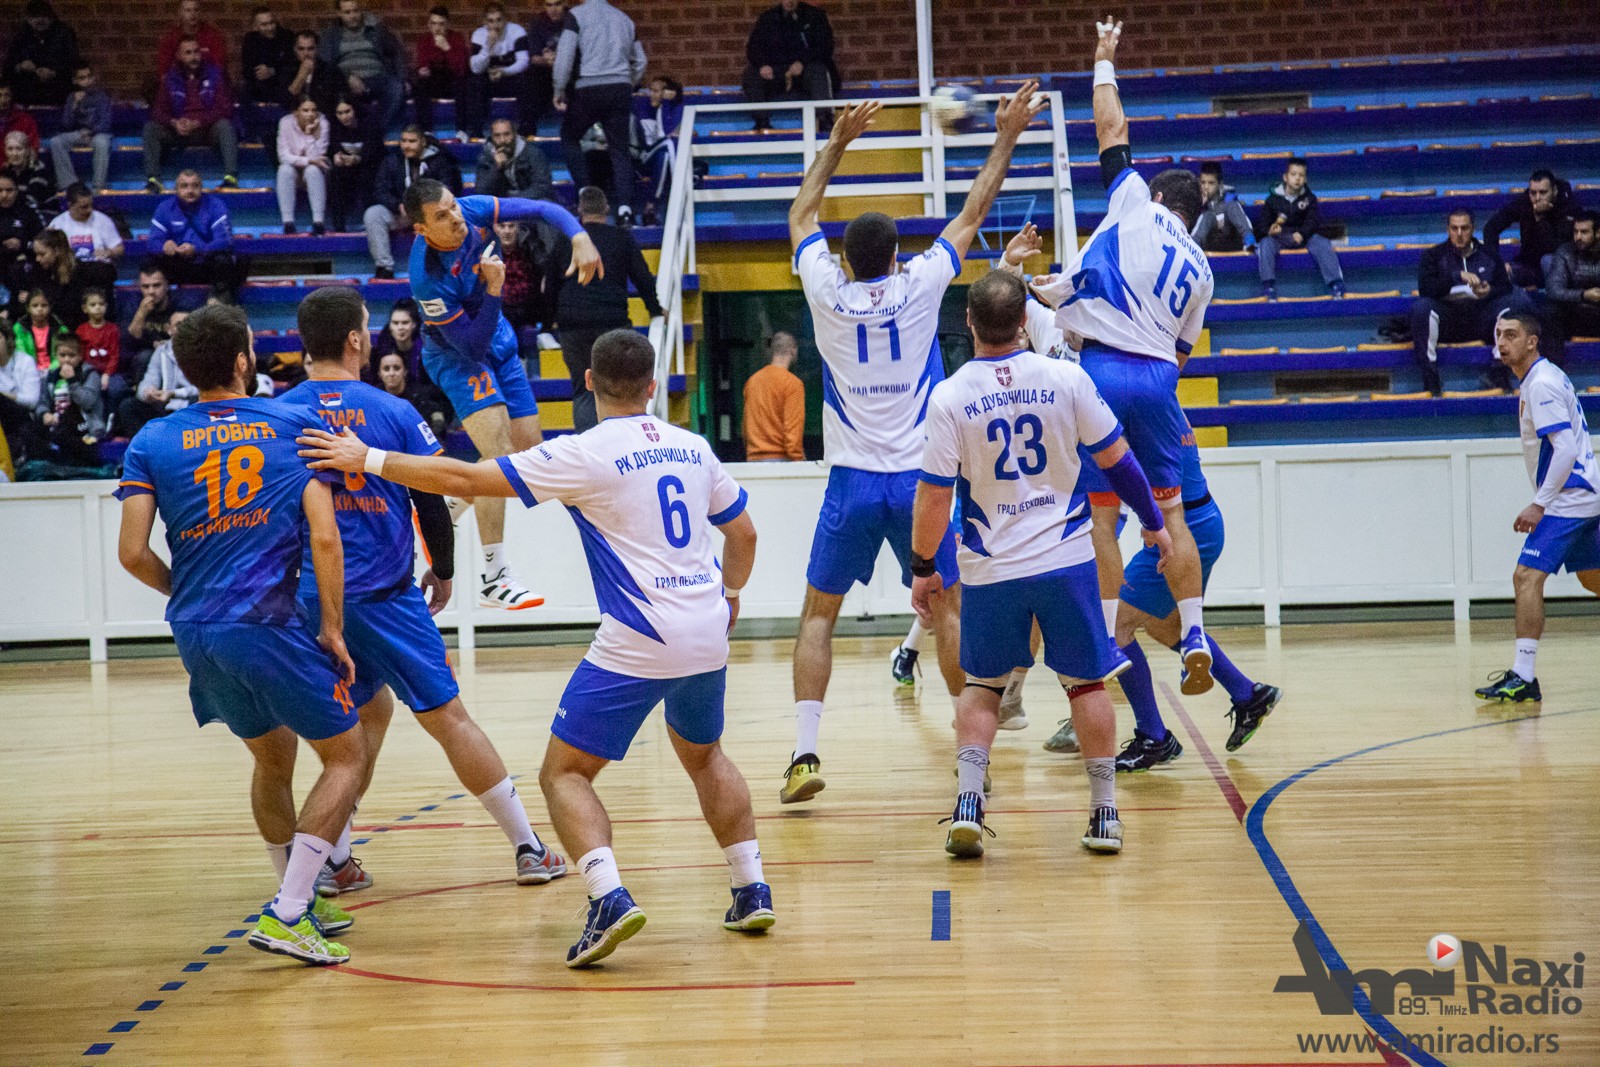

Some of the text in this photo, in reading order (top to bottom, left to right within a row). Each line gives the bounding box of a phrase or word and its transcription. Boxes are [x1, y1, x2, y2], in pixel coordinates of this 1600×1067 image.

[1166, 219, 1205, 269] ДУБОЧИЦА
[1153, 243, 1200, 318] 15
[857, 318, 901, 363] 11
[468, 371, 497, 401] 22
[964, 389, 1055, 420] РК ДУБОЧИЦА 54
[182, 421, 277, 450] ВРГОВИЋ
[987, 413, 1047, 480] 23
[615, 447, 702, 476] РК ДУБОЧИЦА 54
[193, 444, 265, 518] 18
[657, 475, 692, 550] 6
[997, 503, 1016, 516] ГРАД
[655, 576, 679, 588] ГРАД
